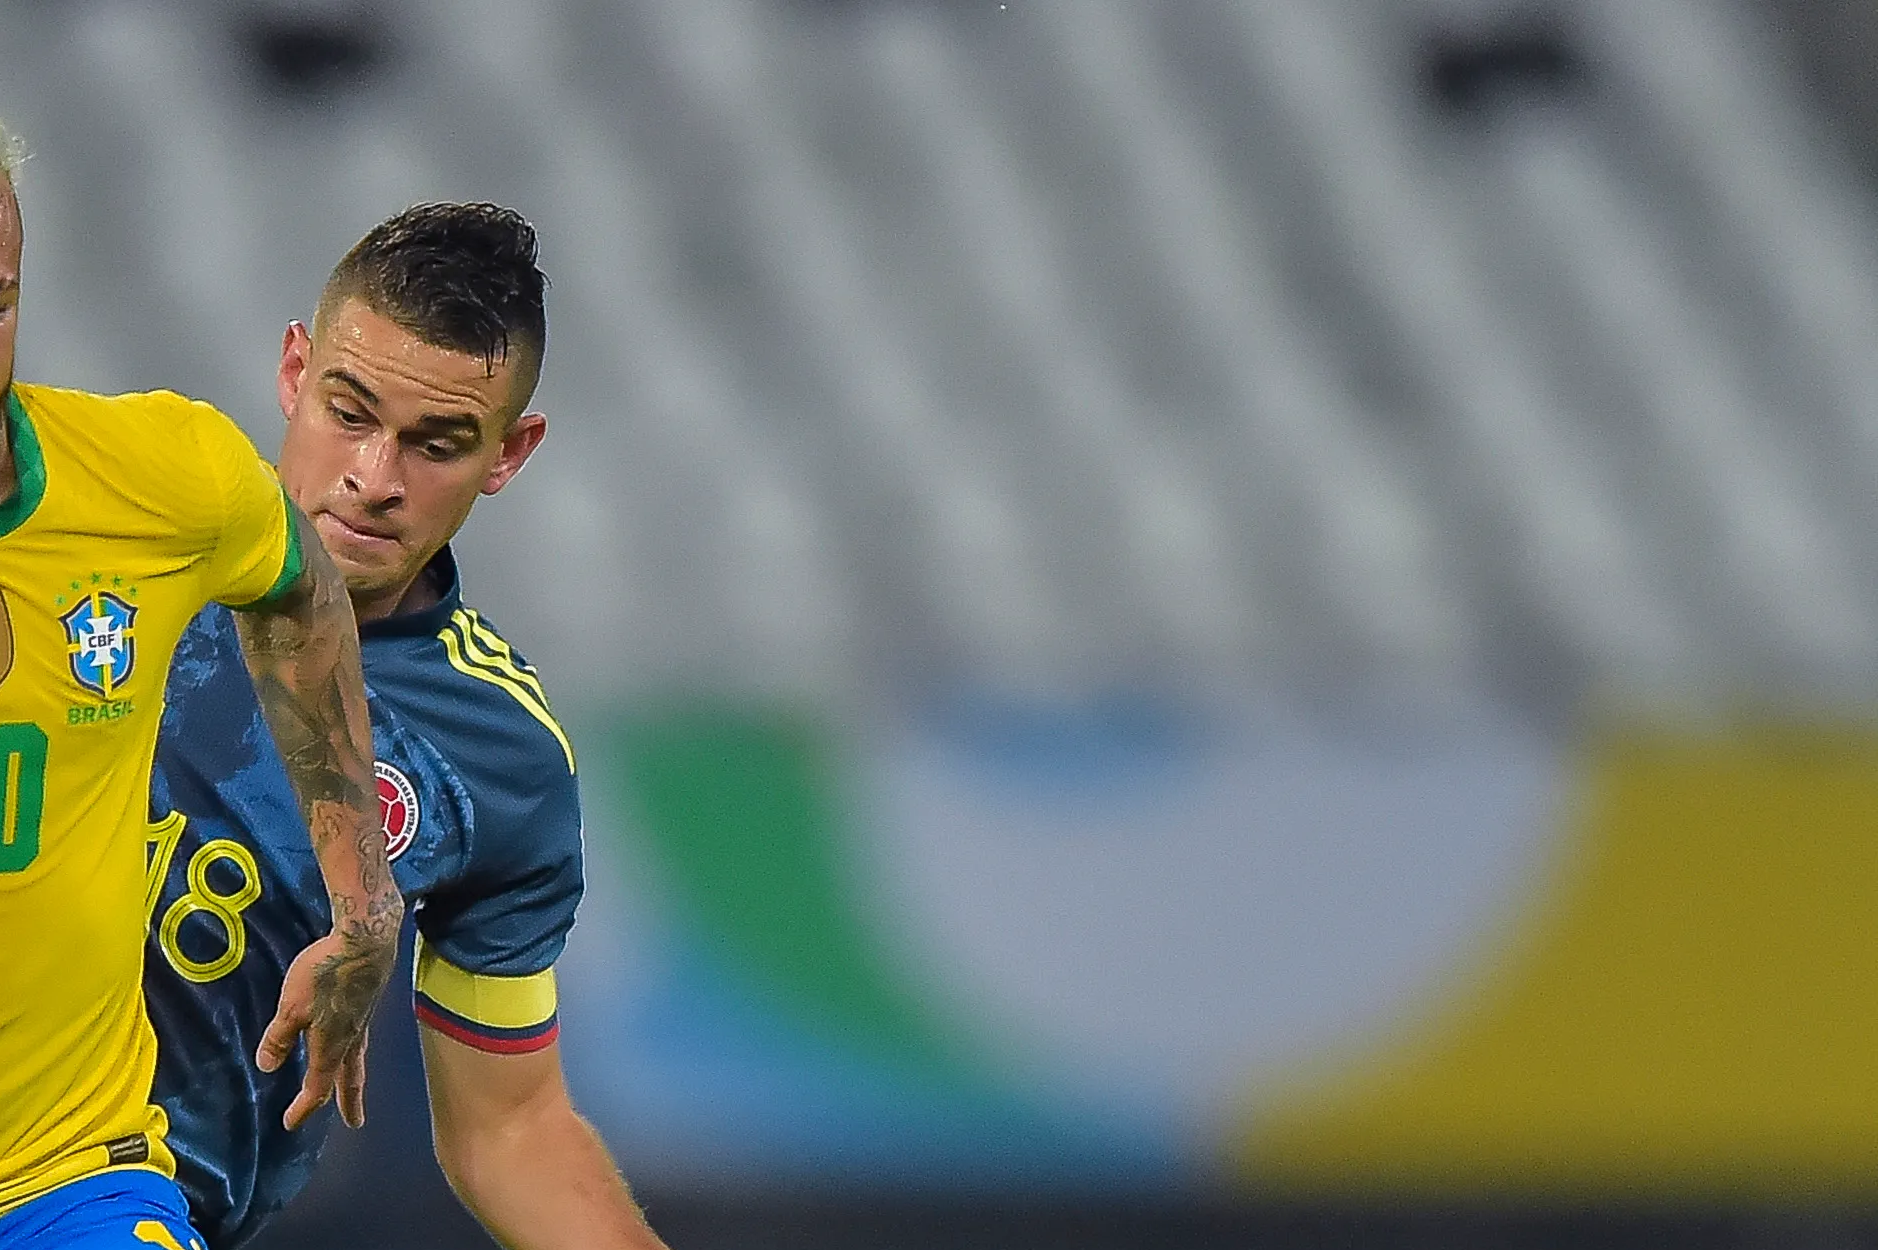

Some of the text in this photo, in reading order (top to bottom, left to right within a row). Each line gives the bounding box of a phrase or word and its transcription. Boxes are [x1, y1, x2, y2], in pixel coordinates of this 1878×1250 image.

[88, 634, 115, 648] CBF
[68, 700, 134, 725] BRASIL
[145, 810, 262, 983] 18
